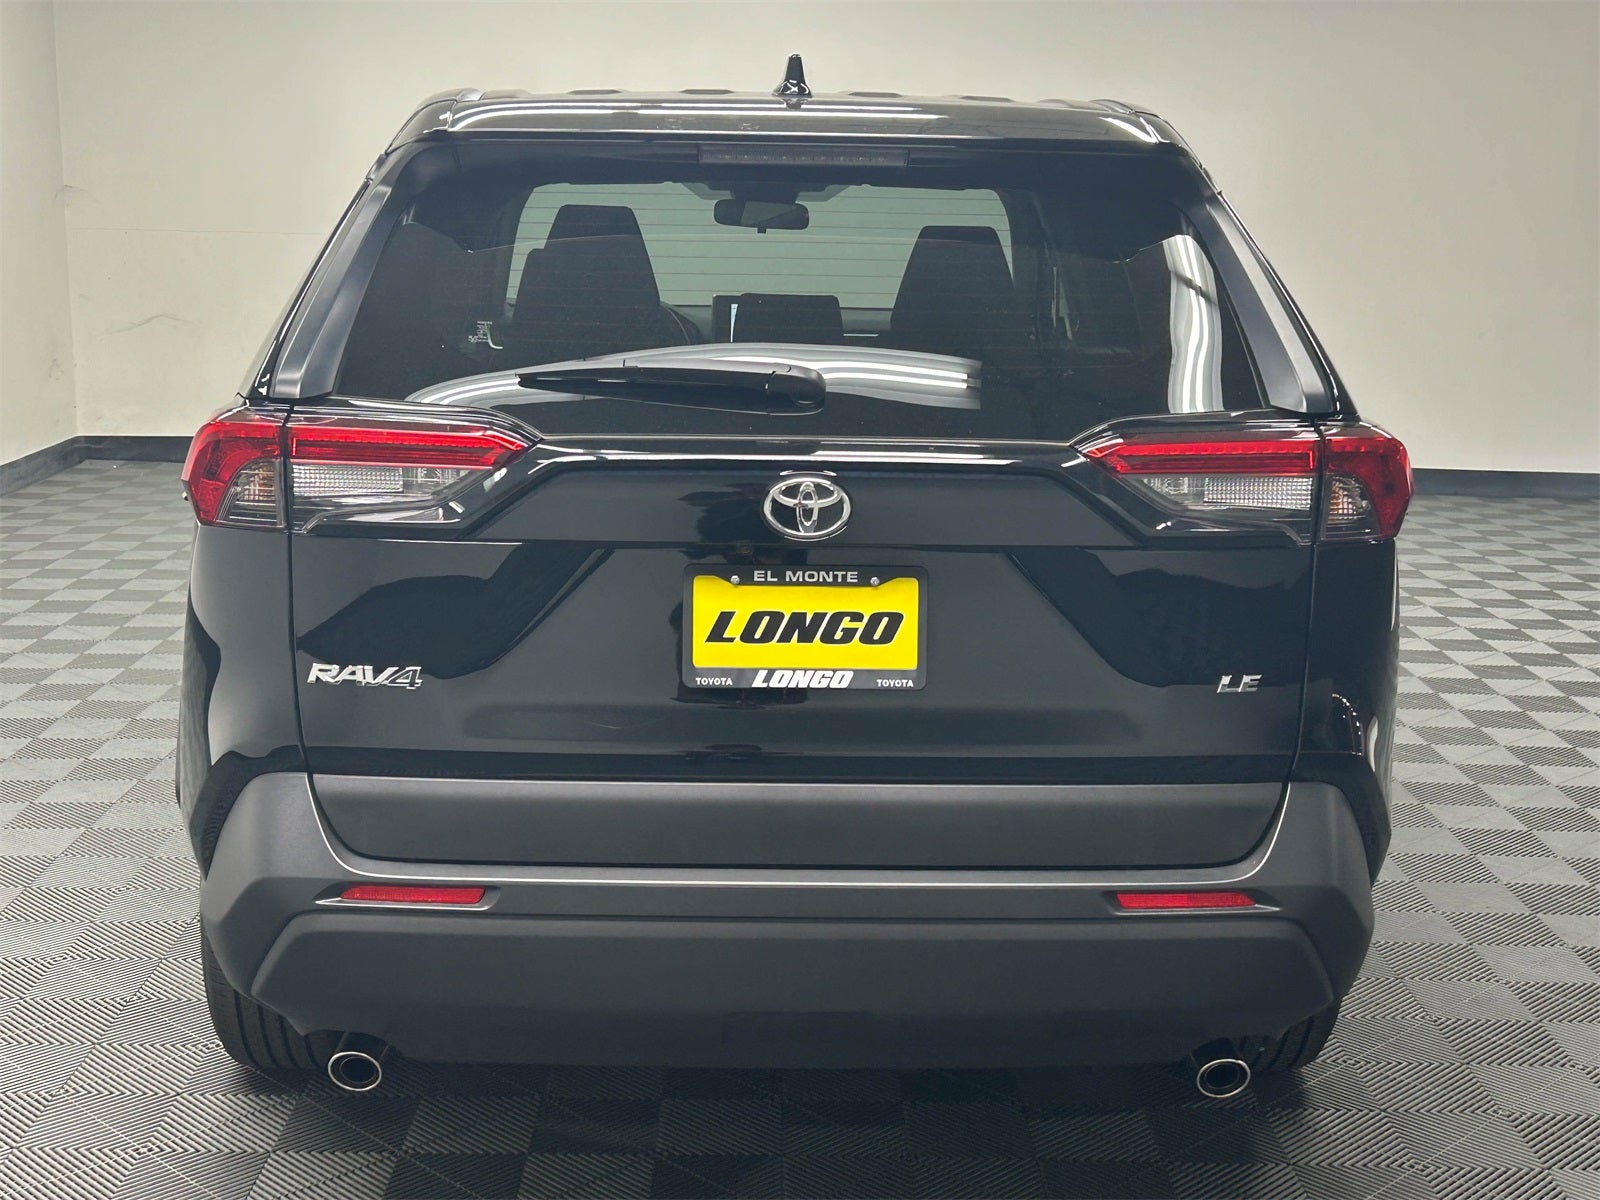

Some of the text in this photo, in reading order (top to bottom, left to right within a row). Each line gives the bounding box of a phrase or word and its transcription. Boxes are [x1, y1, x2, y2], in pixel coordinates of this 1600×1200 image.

[753, 570, 858, 583] EL MONTE
[704, 610, 905, 645] LONGO
[307, 663, 423, 690] RAV4
[695, 677, 733, 686] TOYOTA
[751, 670, 854, 689] LONGO
[876, 679, 914, 688] TOYOTA
[1216, 674, 1263, 694] LE
